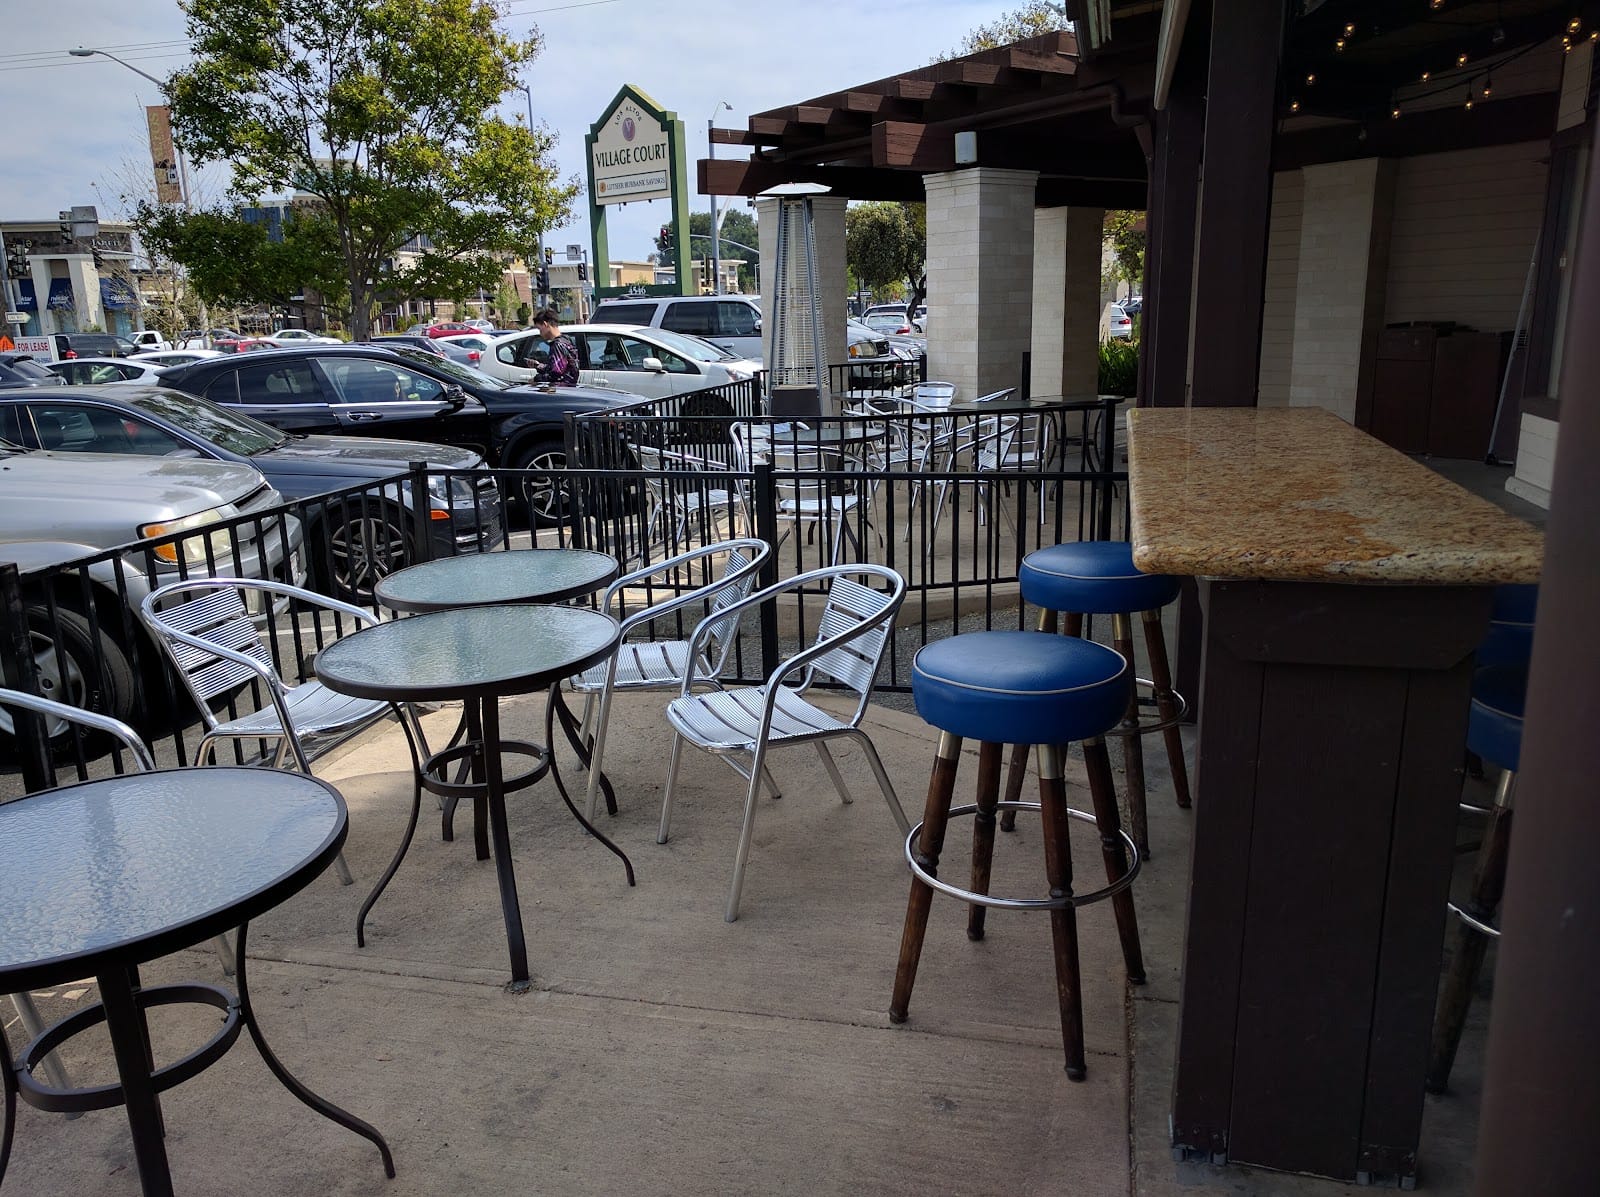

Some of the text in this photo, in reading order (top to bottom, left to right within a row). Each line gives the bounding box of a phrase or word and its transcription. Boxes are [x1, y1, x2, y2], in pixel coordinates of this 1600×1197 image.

[614, 106, 642, 125] LOS ALTOS
[596, 143, 666, 168] VILLAGE COURT
[624, 179, 645, 189] BURBANK
[645, 178, 666, 187] SAVINGS
[17, 342, 49, 352] FOR LEASE
